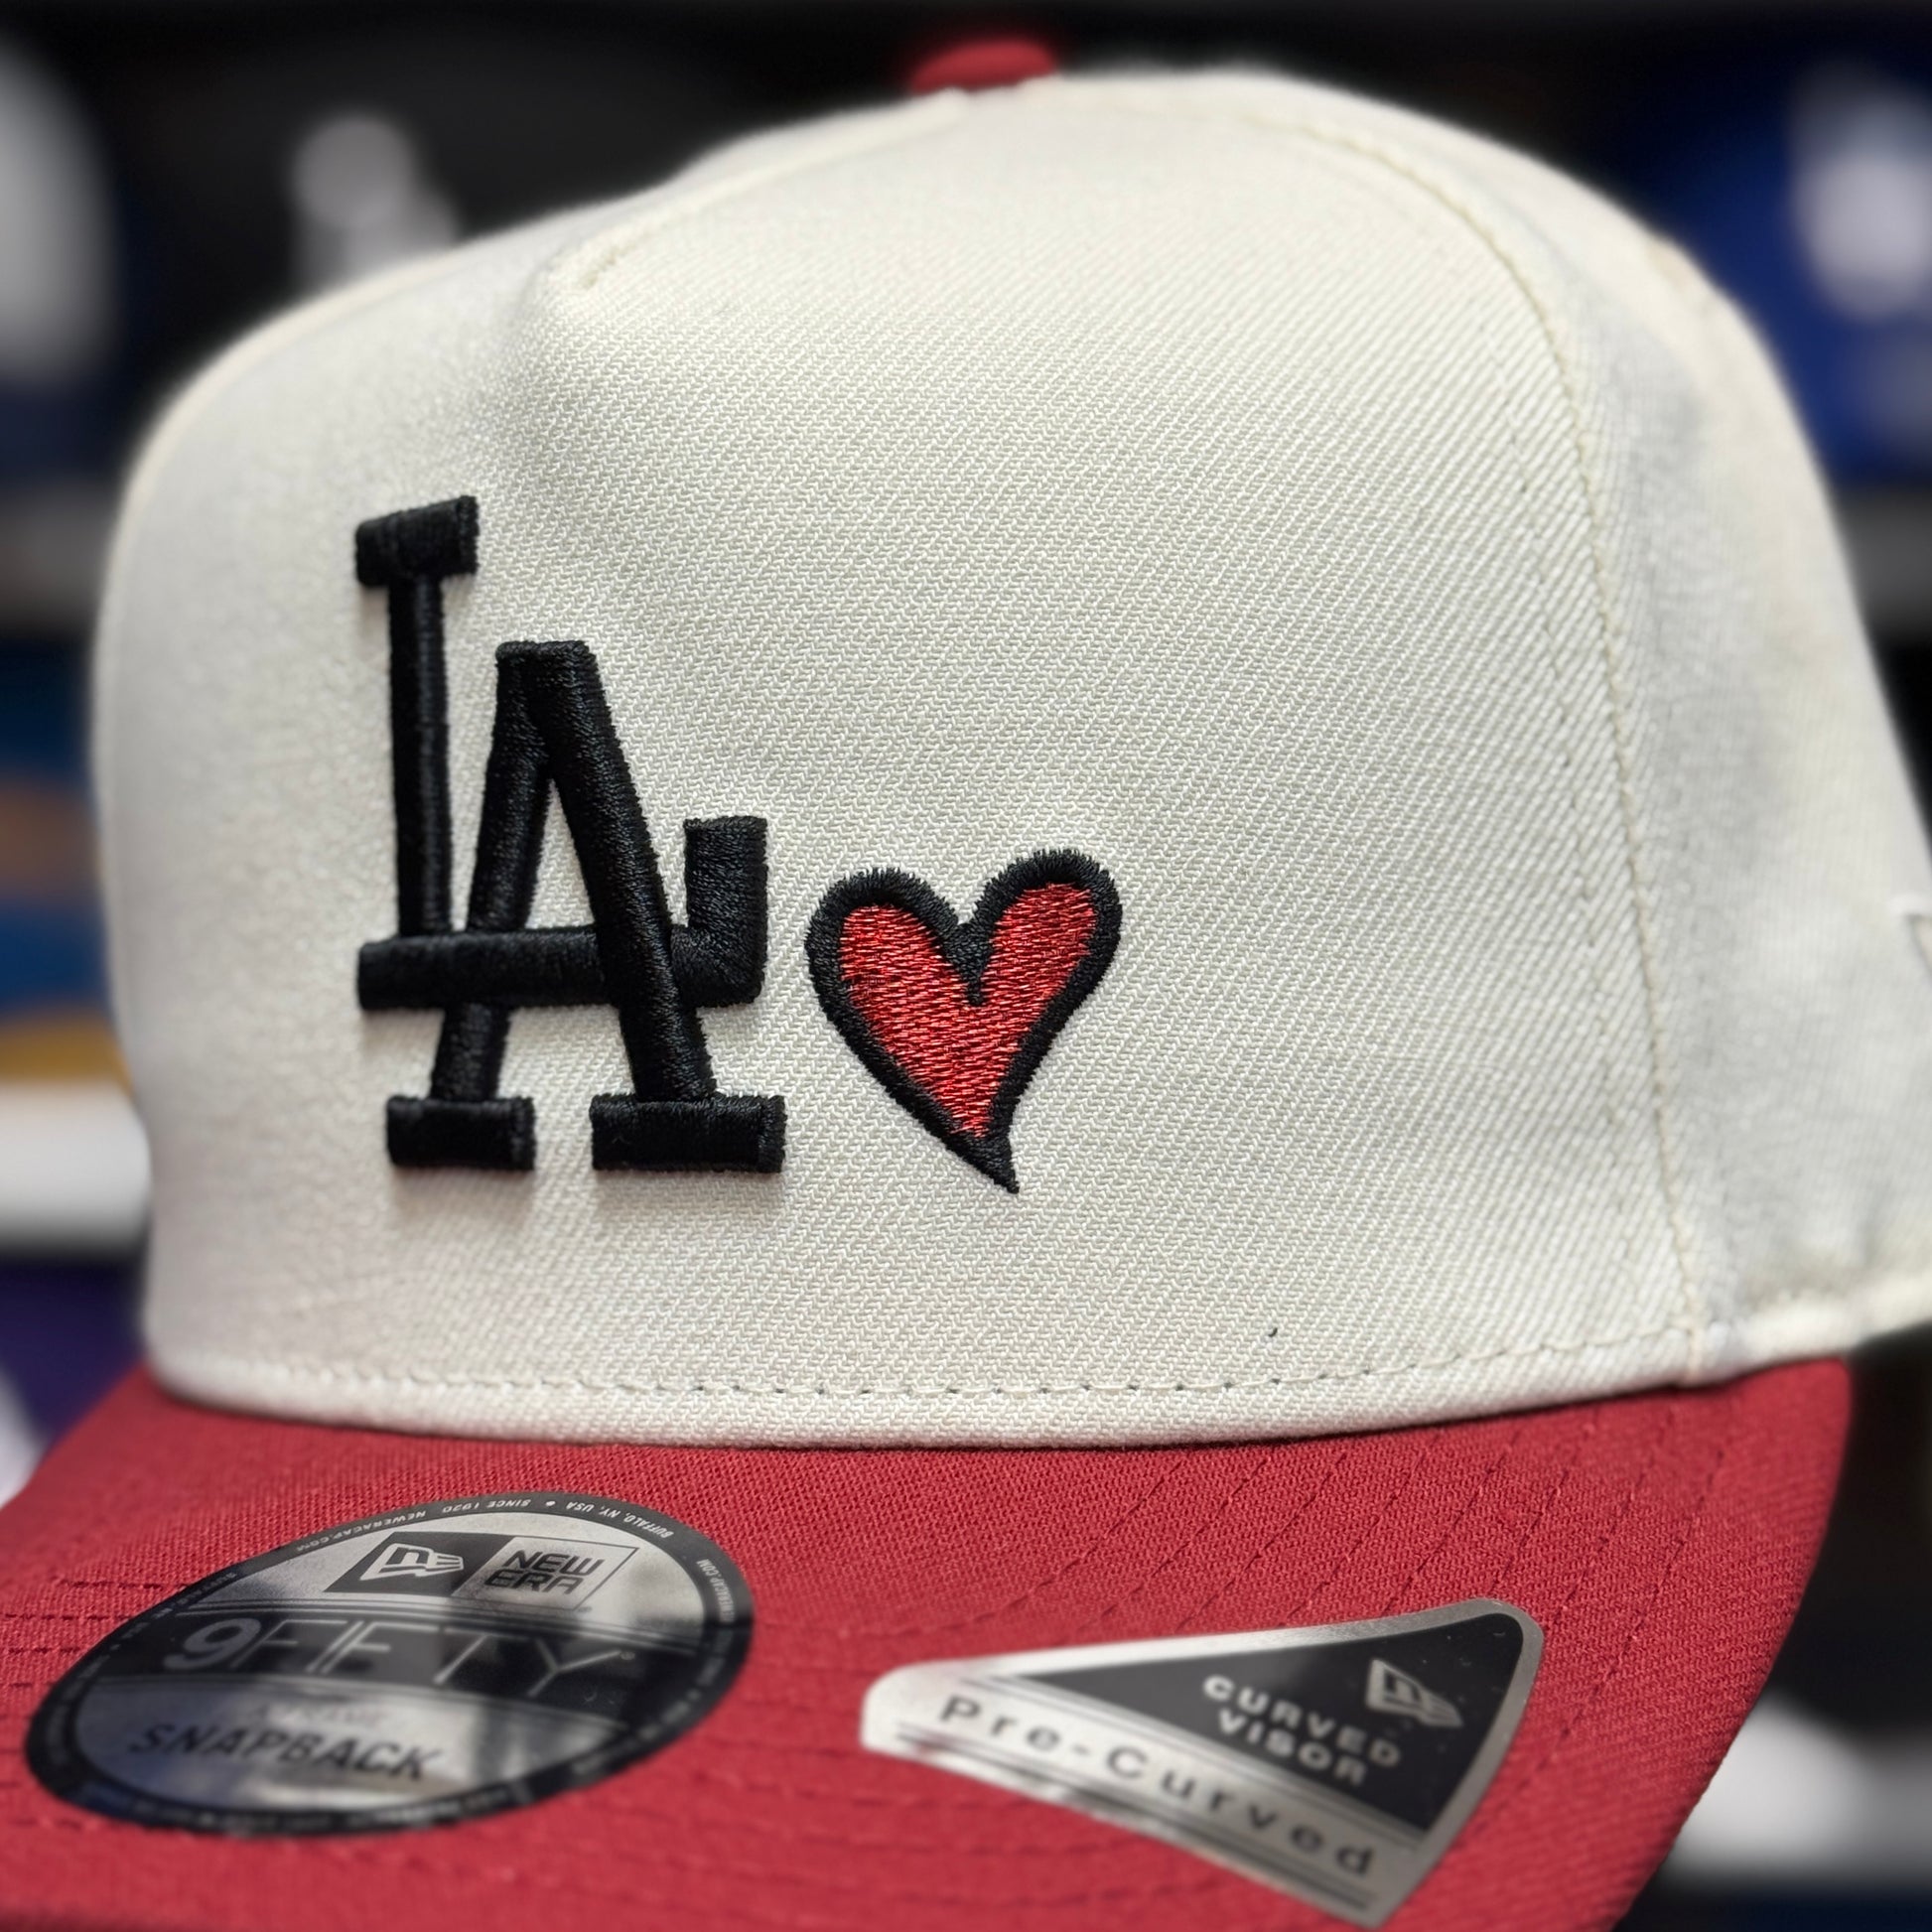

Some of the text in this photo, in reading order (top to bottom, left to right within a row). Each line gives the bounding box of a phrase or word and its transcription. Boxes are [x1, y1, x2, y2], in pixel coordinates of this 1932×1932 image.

[355, 494, 785, 1173] LA
[442, 1502, 481, 1514] 1920
[486, 1498, 532, 1510] SINCE
[565, 1501, 595, 1513] USA
[622, 1512, 675, 1539] BUFFALO,
[501, 1549, 606, 1577] NEW
[483, 1568, 585, 1595] ERA
[1202, 1673, 1402, 1768] CURVED
[131, 1723, 443, 1781] SNAPBACK
[1217, 1708, 1367, 1786] VISOR
[938, 1695, 1375, 1878] Pre-Curved
